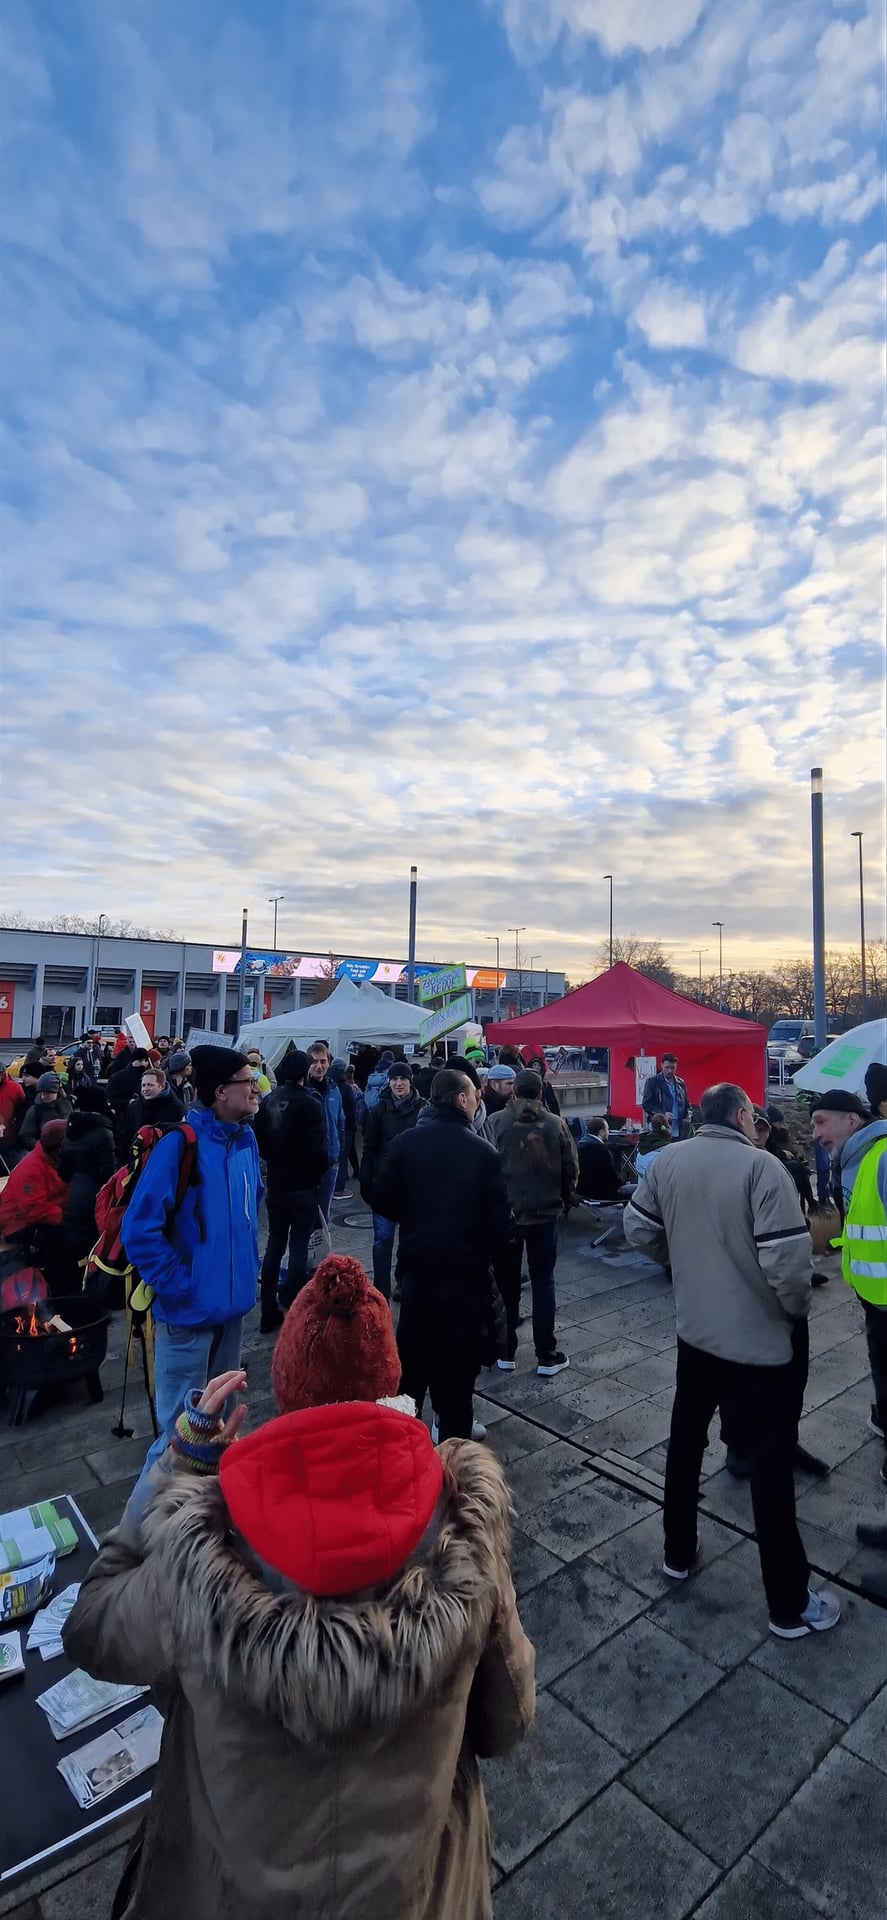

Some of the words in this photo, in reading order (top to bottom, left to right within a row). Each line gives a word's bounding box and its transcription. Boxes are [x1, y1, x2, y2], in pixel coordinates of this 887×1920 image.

[431, 976, 456, 994] KEINE
[0, 996, 8, 1009] 6
[143, 1000, 151, 1012] 5
